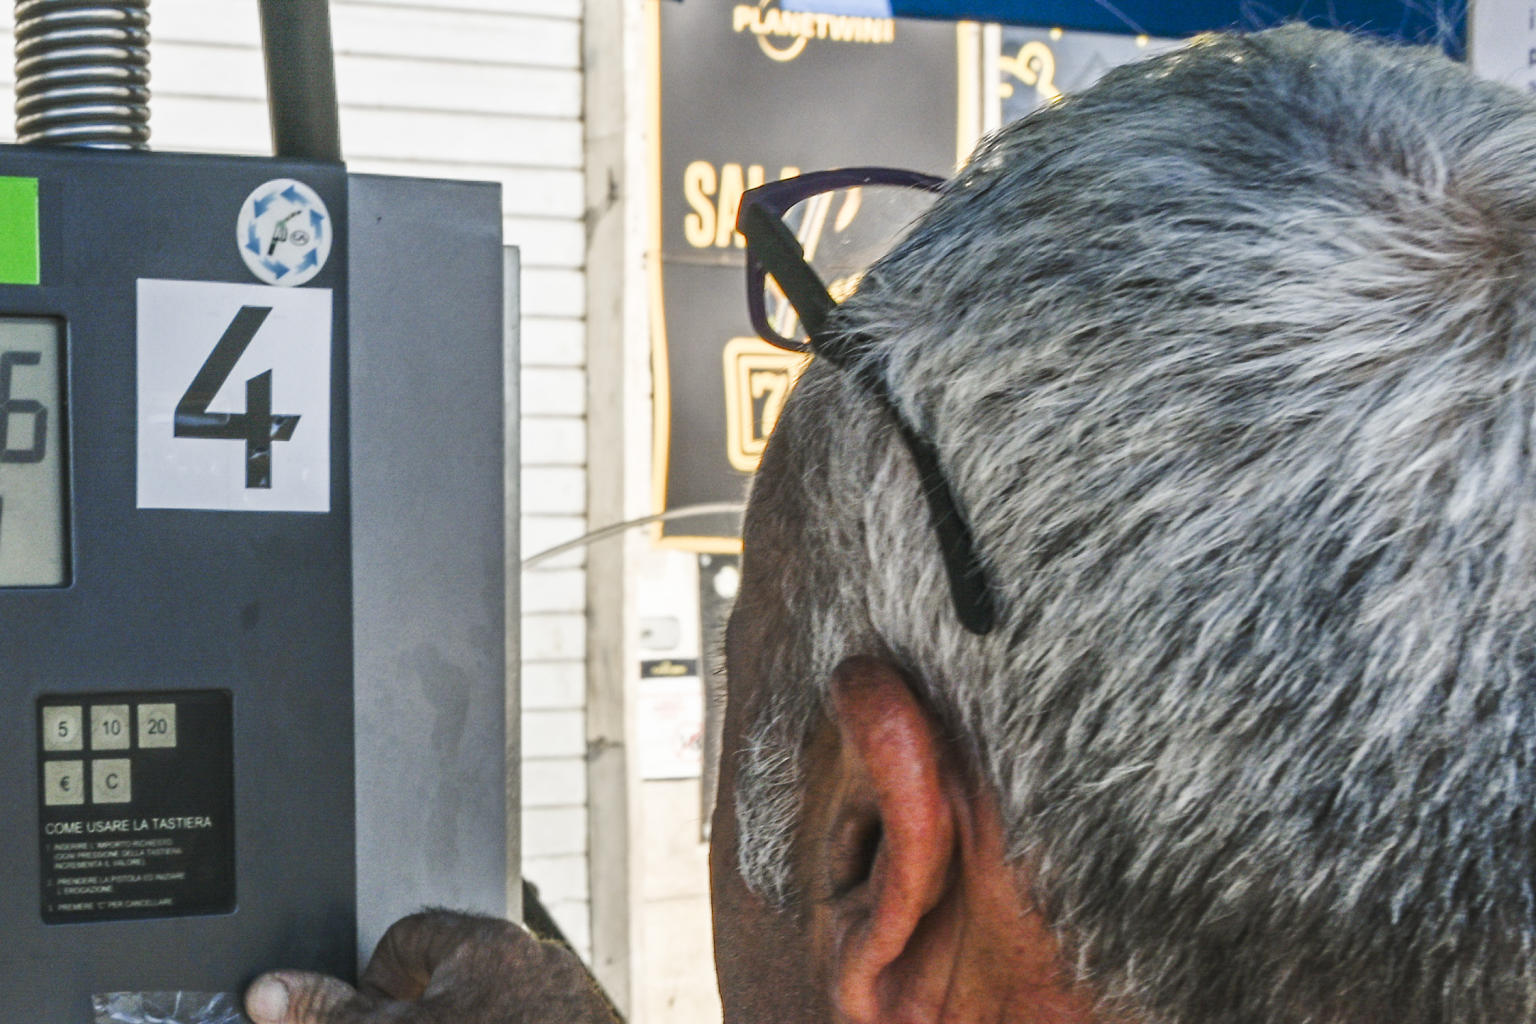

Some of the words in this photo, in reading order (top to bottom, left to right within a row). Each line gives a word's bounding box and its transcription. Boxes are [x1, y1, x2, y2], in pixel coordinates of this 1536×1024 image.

[174, 305, 301, 489] 4
[58, 721, 68, 737] 5
[103, 720, 121, 735] 10
[148, 719, 167, 735] 20
[59, 776, 71, 792] €
[105, 773, 118, 790] C
[45, 821, 83, 835] COME
[86, 819, 130, 833] USARE
[133, 818, 149, 832] LA
[152, 816, 212, 831] TASTIERA
